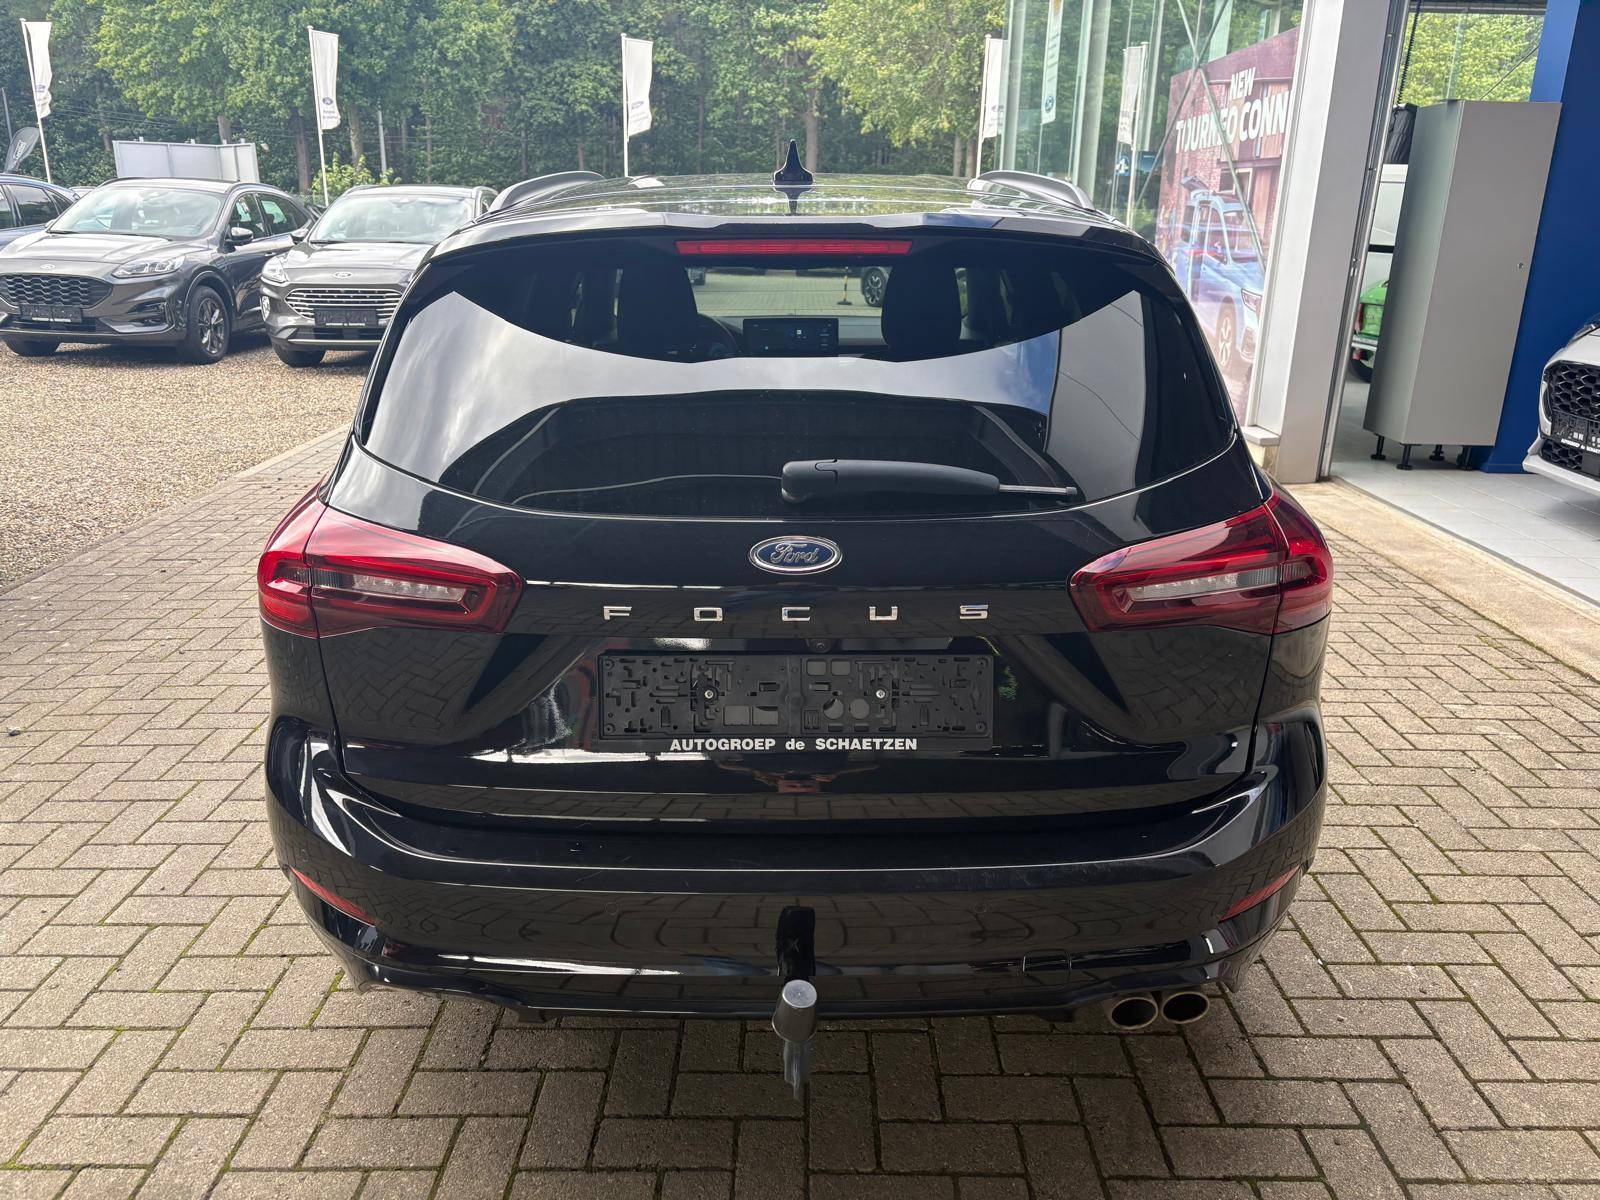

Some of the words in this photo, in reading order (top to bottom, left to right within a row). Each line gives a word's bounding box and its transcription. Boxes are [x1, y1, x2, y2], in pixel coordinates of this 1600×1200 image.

[1230, 68, 1255, 100] NEW
[603, 604, 989, 622] FOCUS
[669, 738, 776, 751] AUTOGROEP
[785, 738, 805, 751] de
[815, 738, 918, 751] SCHAETZEN
